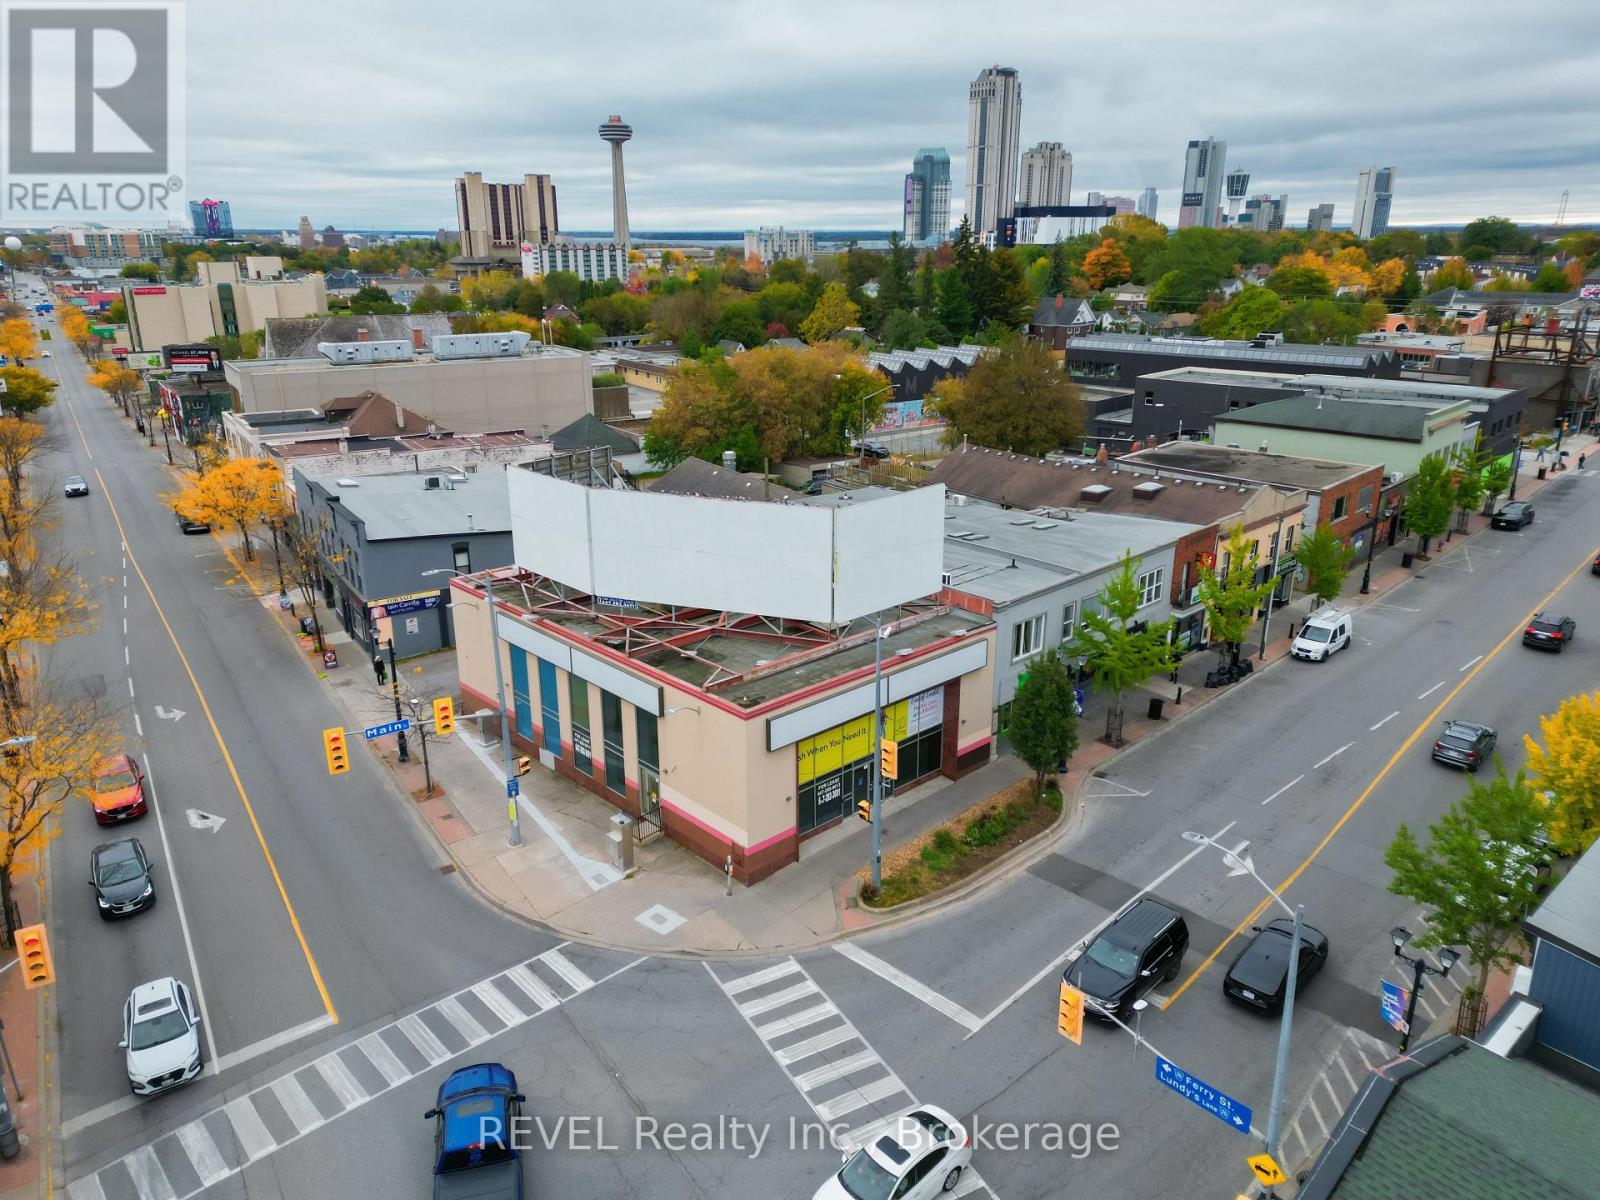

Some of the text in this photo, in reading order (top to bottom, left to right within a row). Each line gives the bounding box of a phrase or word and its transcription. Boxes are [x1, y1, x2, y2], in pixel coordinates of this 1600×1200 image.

[367, 724, 402, 738] Main
[806, 744, 828, 757] When
[829, 739, 842, 748] You
[843, 728, 861, 741] Need
[1160, 1071, 1200, 1101] Lundy's
[1202, 1099, 1218, 1113] Lane
[1185, 1076, 1215, 1100] Ferry
